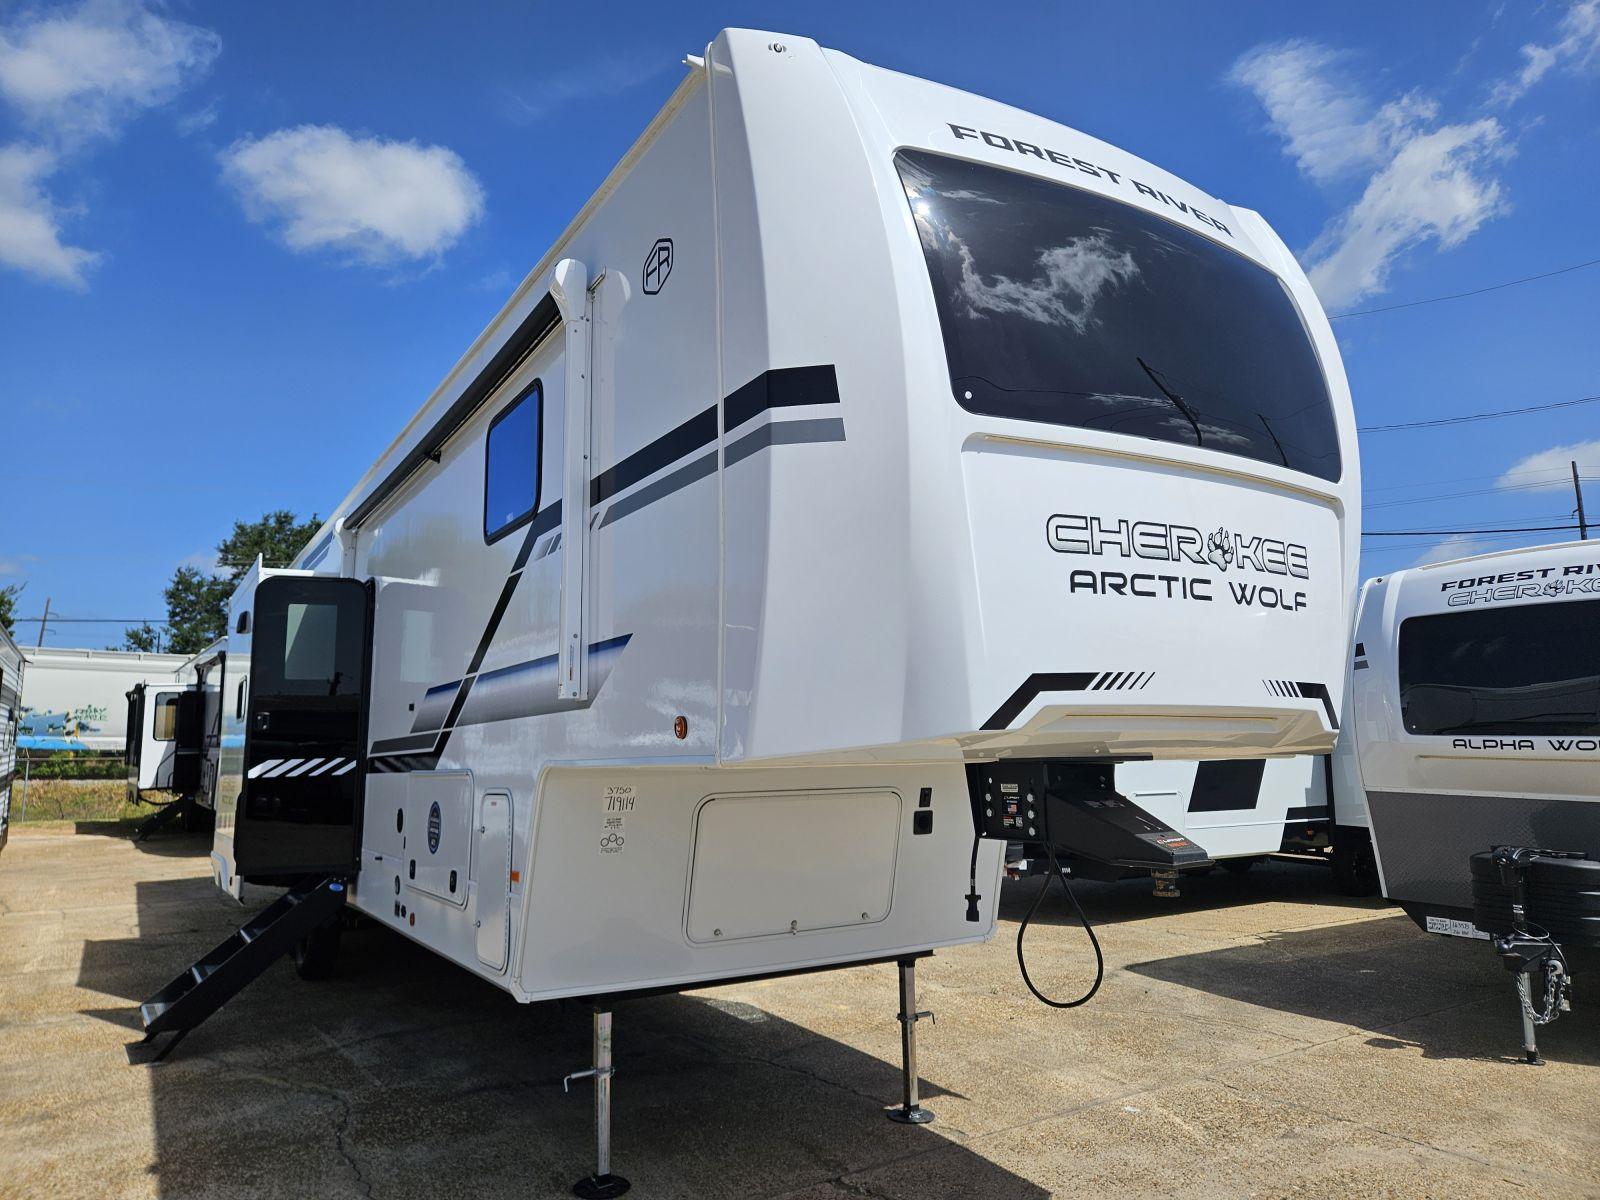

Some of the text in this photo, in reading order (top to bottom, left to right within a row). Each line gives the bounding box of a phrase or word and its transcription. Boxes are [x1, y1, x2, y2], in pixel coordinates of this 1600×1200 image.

[946, 122, 1235, 238] FOREST RIVER
[1069, 569, 1307, 612] ARCTIC WOLF
[1440, 563, 1600, 592] FOREST RI
[1453, 738, 1600, 751] ALPHA WO
[604, 796, 635, 811] 719114
